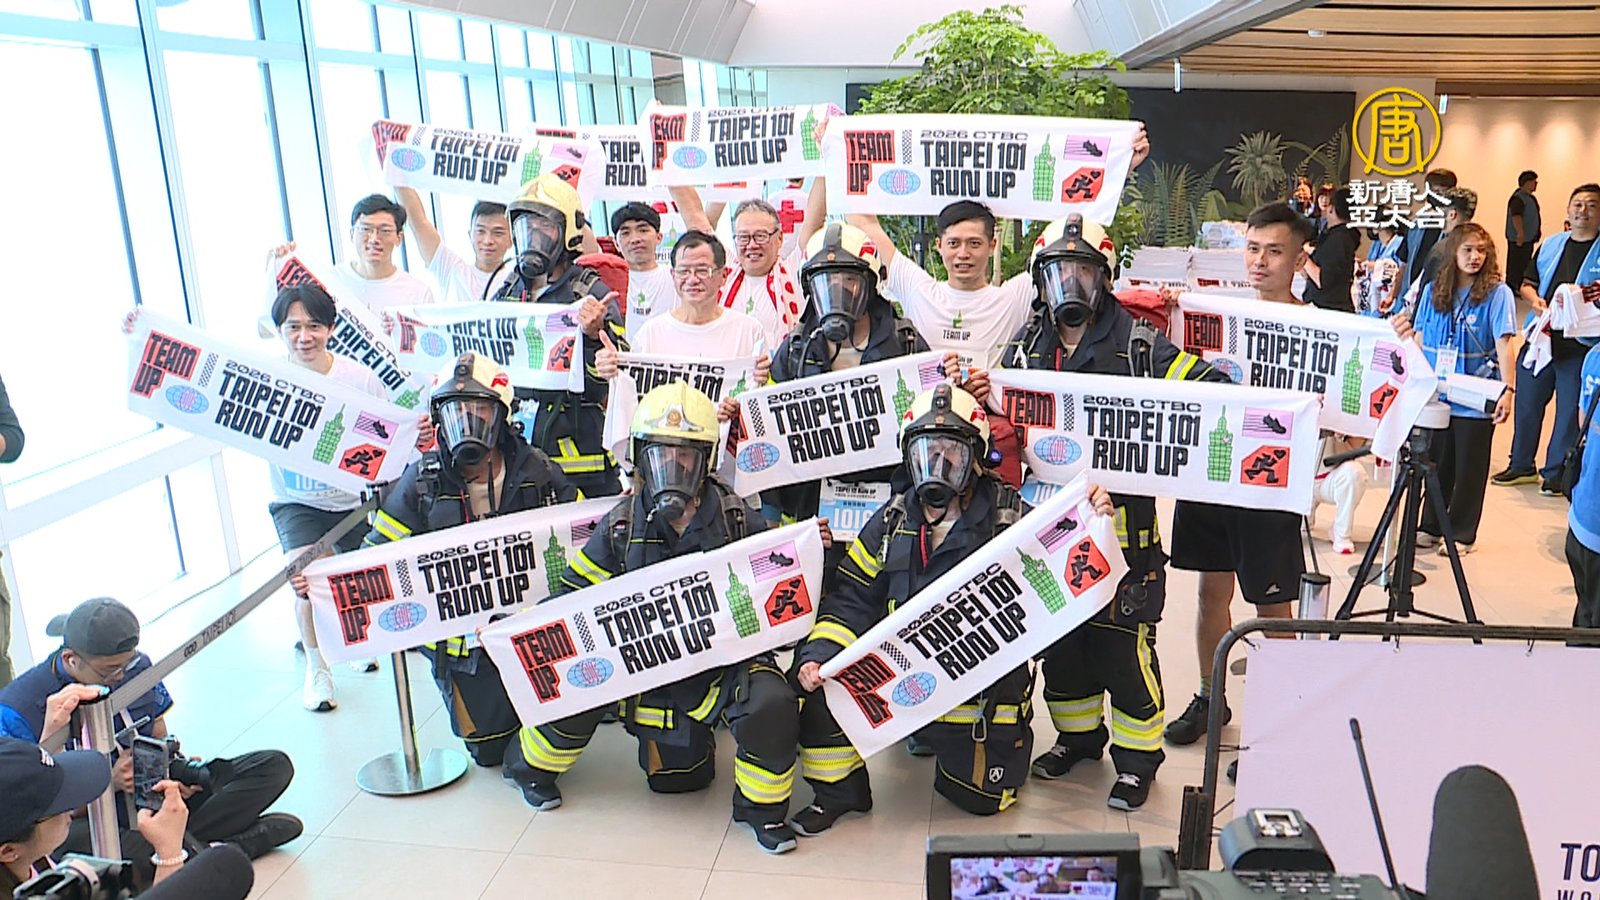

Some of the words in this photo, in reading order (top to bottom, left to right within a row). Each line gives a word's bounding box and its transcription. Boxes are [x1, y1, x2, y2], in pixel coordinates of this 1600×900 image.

[653, 115, 685, 141] EAM
[708, 115, 768, 142] TAIPEI
[770, 113, 795, 136] 101
[846, 131, 893, 162] TEAM
[920, 130, 968, 138] 2026
[973, 131, 1028, 141] CTBC
[431, 135, 492, 160] TAIPEI
[493, 143, 521, 162] 101
[715, 141, 758, 168] RUN
[762, 139, 788, 164] UP
[920, 140, 993, 168] TAIPEI
[997, 142, 1026, 170] 101
[433, 153, 478, 182] RUN
[481, 161, 508, 186] UP
[605, 164, 647, 186] RUN
[849, 163, 870, 192] UP
[930, 169, 981, 197] RUN
[986, 172, 1015, 199] UP
[341, 307, 375, 341] 2026
[943, 329, 960, 340] TEAM
[962, 331, 971, 341] UP
[1185, 313, 1221, 351] TEAM
[1244, 317, 1284, 331] 2026
[1288, 325, 1339, 341] CTBC
[145, 333, 198, 378] TEAM
[334, 313, 385, 370] TAIPEI
[378, 364, 406, 391] 101
[489, 339, 515, 366] UP
[1244, 330, 1307, 370] TAIPEI
[1311, 342, 1339, 375] 101
[135, 363, 163, 395] UP
[225, 359, 272, 382] 2026
[275, 378, 327, 404] CTBC
[767, 388, 816, 404] 2026
[820, 374, 879, 393] CTBC
[1250, 363, 1294, 391] RUN
[218, 370, 286, 418] TAIPEI
[287, 398, 323, 430] 101
[769, 390, 850, 436] TAIPEI
[850, 386, 886, 418] 101
[1004, 389, 1055, 426] TEAM
[1083, 396, 1135, 407] 2026
[1140, 399, 1202, 413] CTBC
[215, 399, 274, 440] RUN
[270, 419, 304, 450] UP
[787, 427, 848, 464] RUN
[852, 418, 881, 452] UP
[1083, 406, 1163, 445] TAIPEI
[1168, 412, 1200, 447] 101
[1092, 439, 1150, 474] RUN
[1155, 445, 1188, 477] UP
[417, 545, 469, 564] 2026
[474, 531, 533, 549] CTBC
[418, 548, 501, 594] TAIPEI
[503, 541, 537, 572] 101
[331, 569, 391, 605] TEAM
[436, 584, 495, 623] RUN
[497, 573, 530, 605] UP
[593, 592, 646, 617] 2026
[649, 571, 710, 598] CTBC
[896, 601, 945, 639] 2026
[945, 562, 1003, 604] CTBC
[340, 605, 367, 643] UP
[597, 594, 681, 648] TAIPEI
[681, 581, 720, 616] 101
[903, 588, 991, 661] TAIPEI
[978, 569, 1024, 614] 101
[514, 623, 576, 670] TEAM
[618, 632, 682, 676] RUN
[680, 618, 716, 654] UP
[935, 633, 1001, 681] RUN
[995, 602, 1028, 645] UP
[528, 663, 559, 701] UP
[835, 654, 894, 696] TEAM
[860, 690, 890, 725] UP
[1561, 843, 1600, 882] TO
